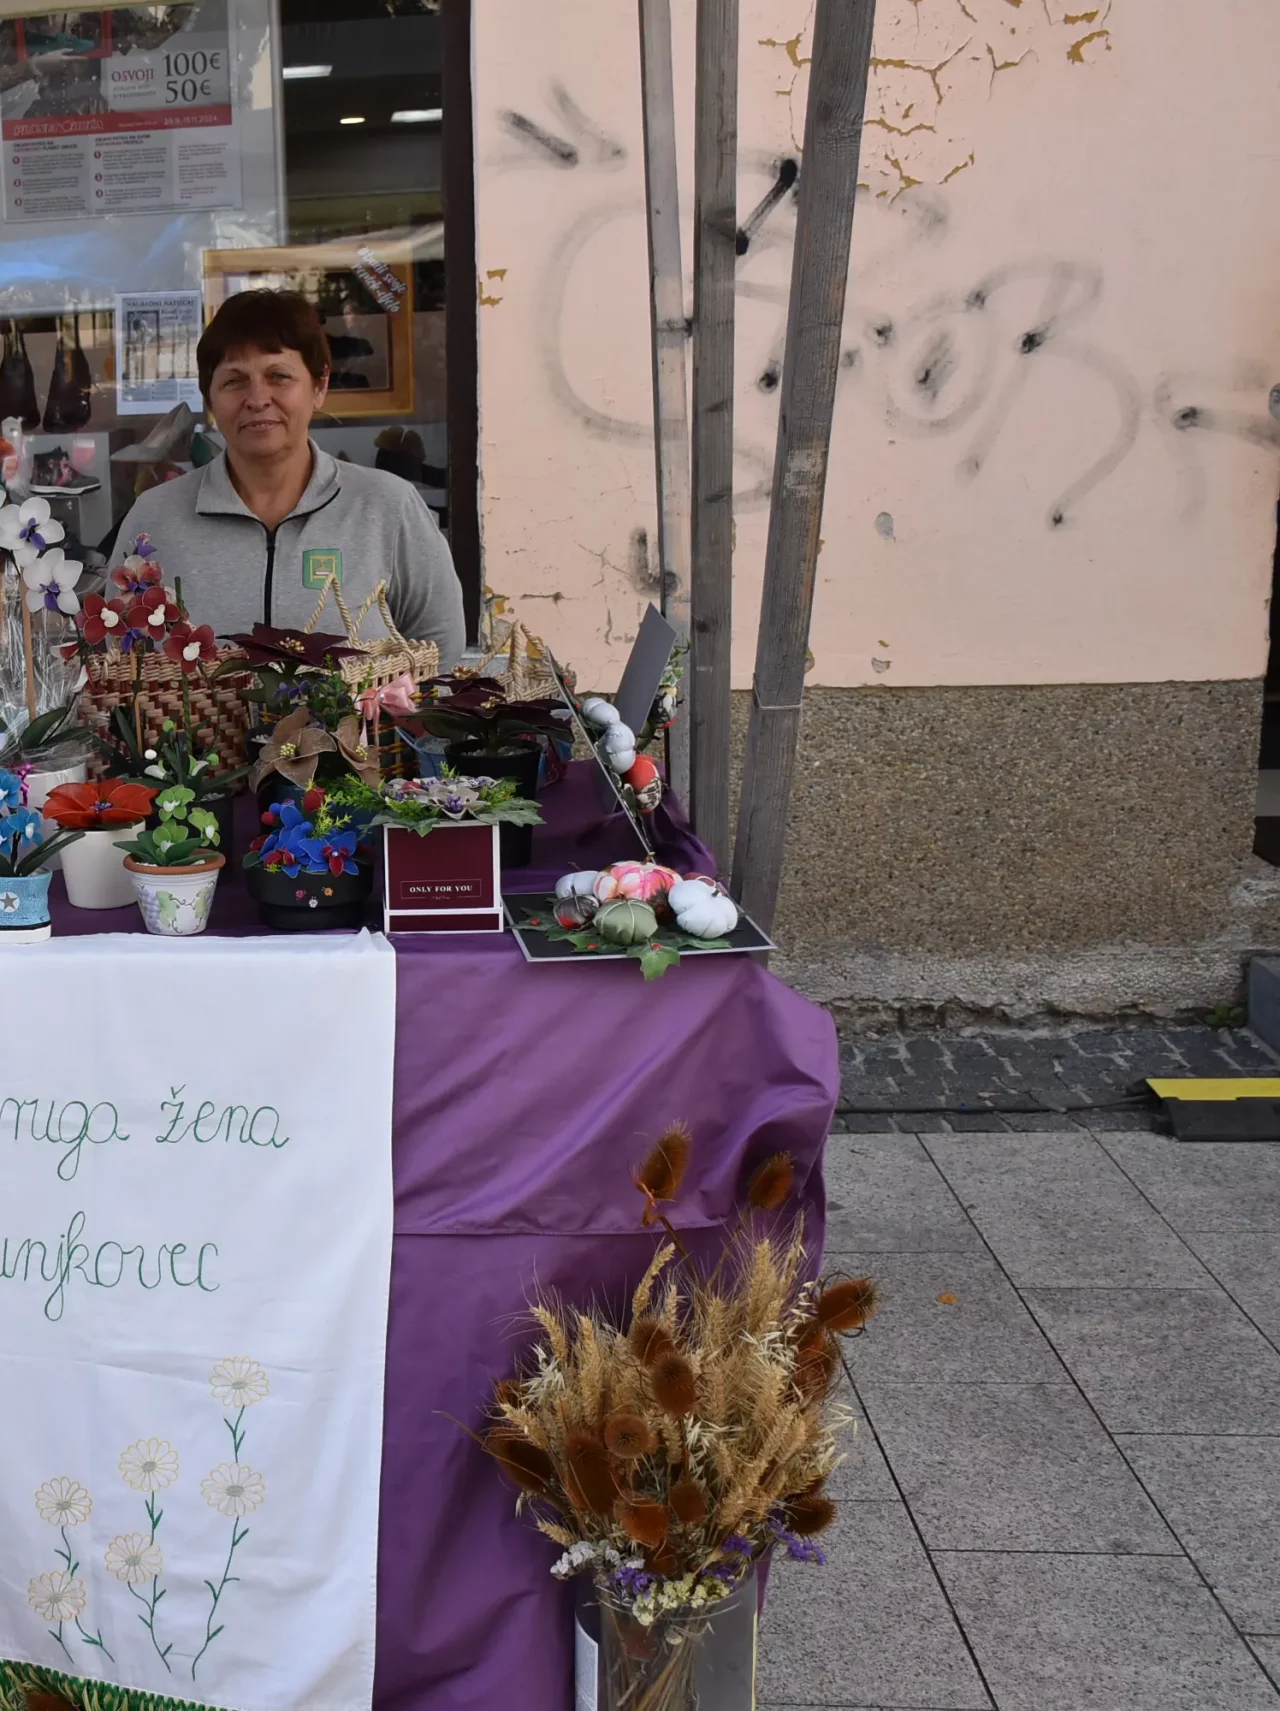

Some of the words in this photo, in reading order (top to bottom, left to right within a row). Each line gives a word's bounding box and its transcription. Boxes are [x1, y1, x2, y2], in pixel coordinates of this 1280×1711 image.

[111, 68, 154, 82] OSVOJI
[163, 51, 221, 77] 100€
[165, 78, 212, 104] 50€
[155, 1083, 290, 1149] žena
